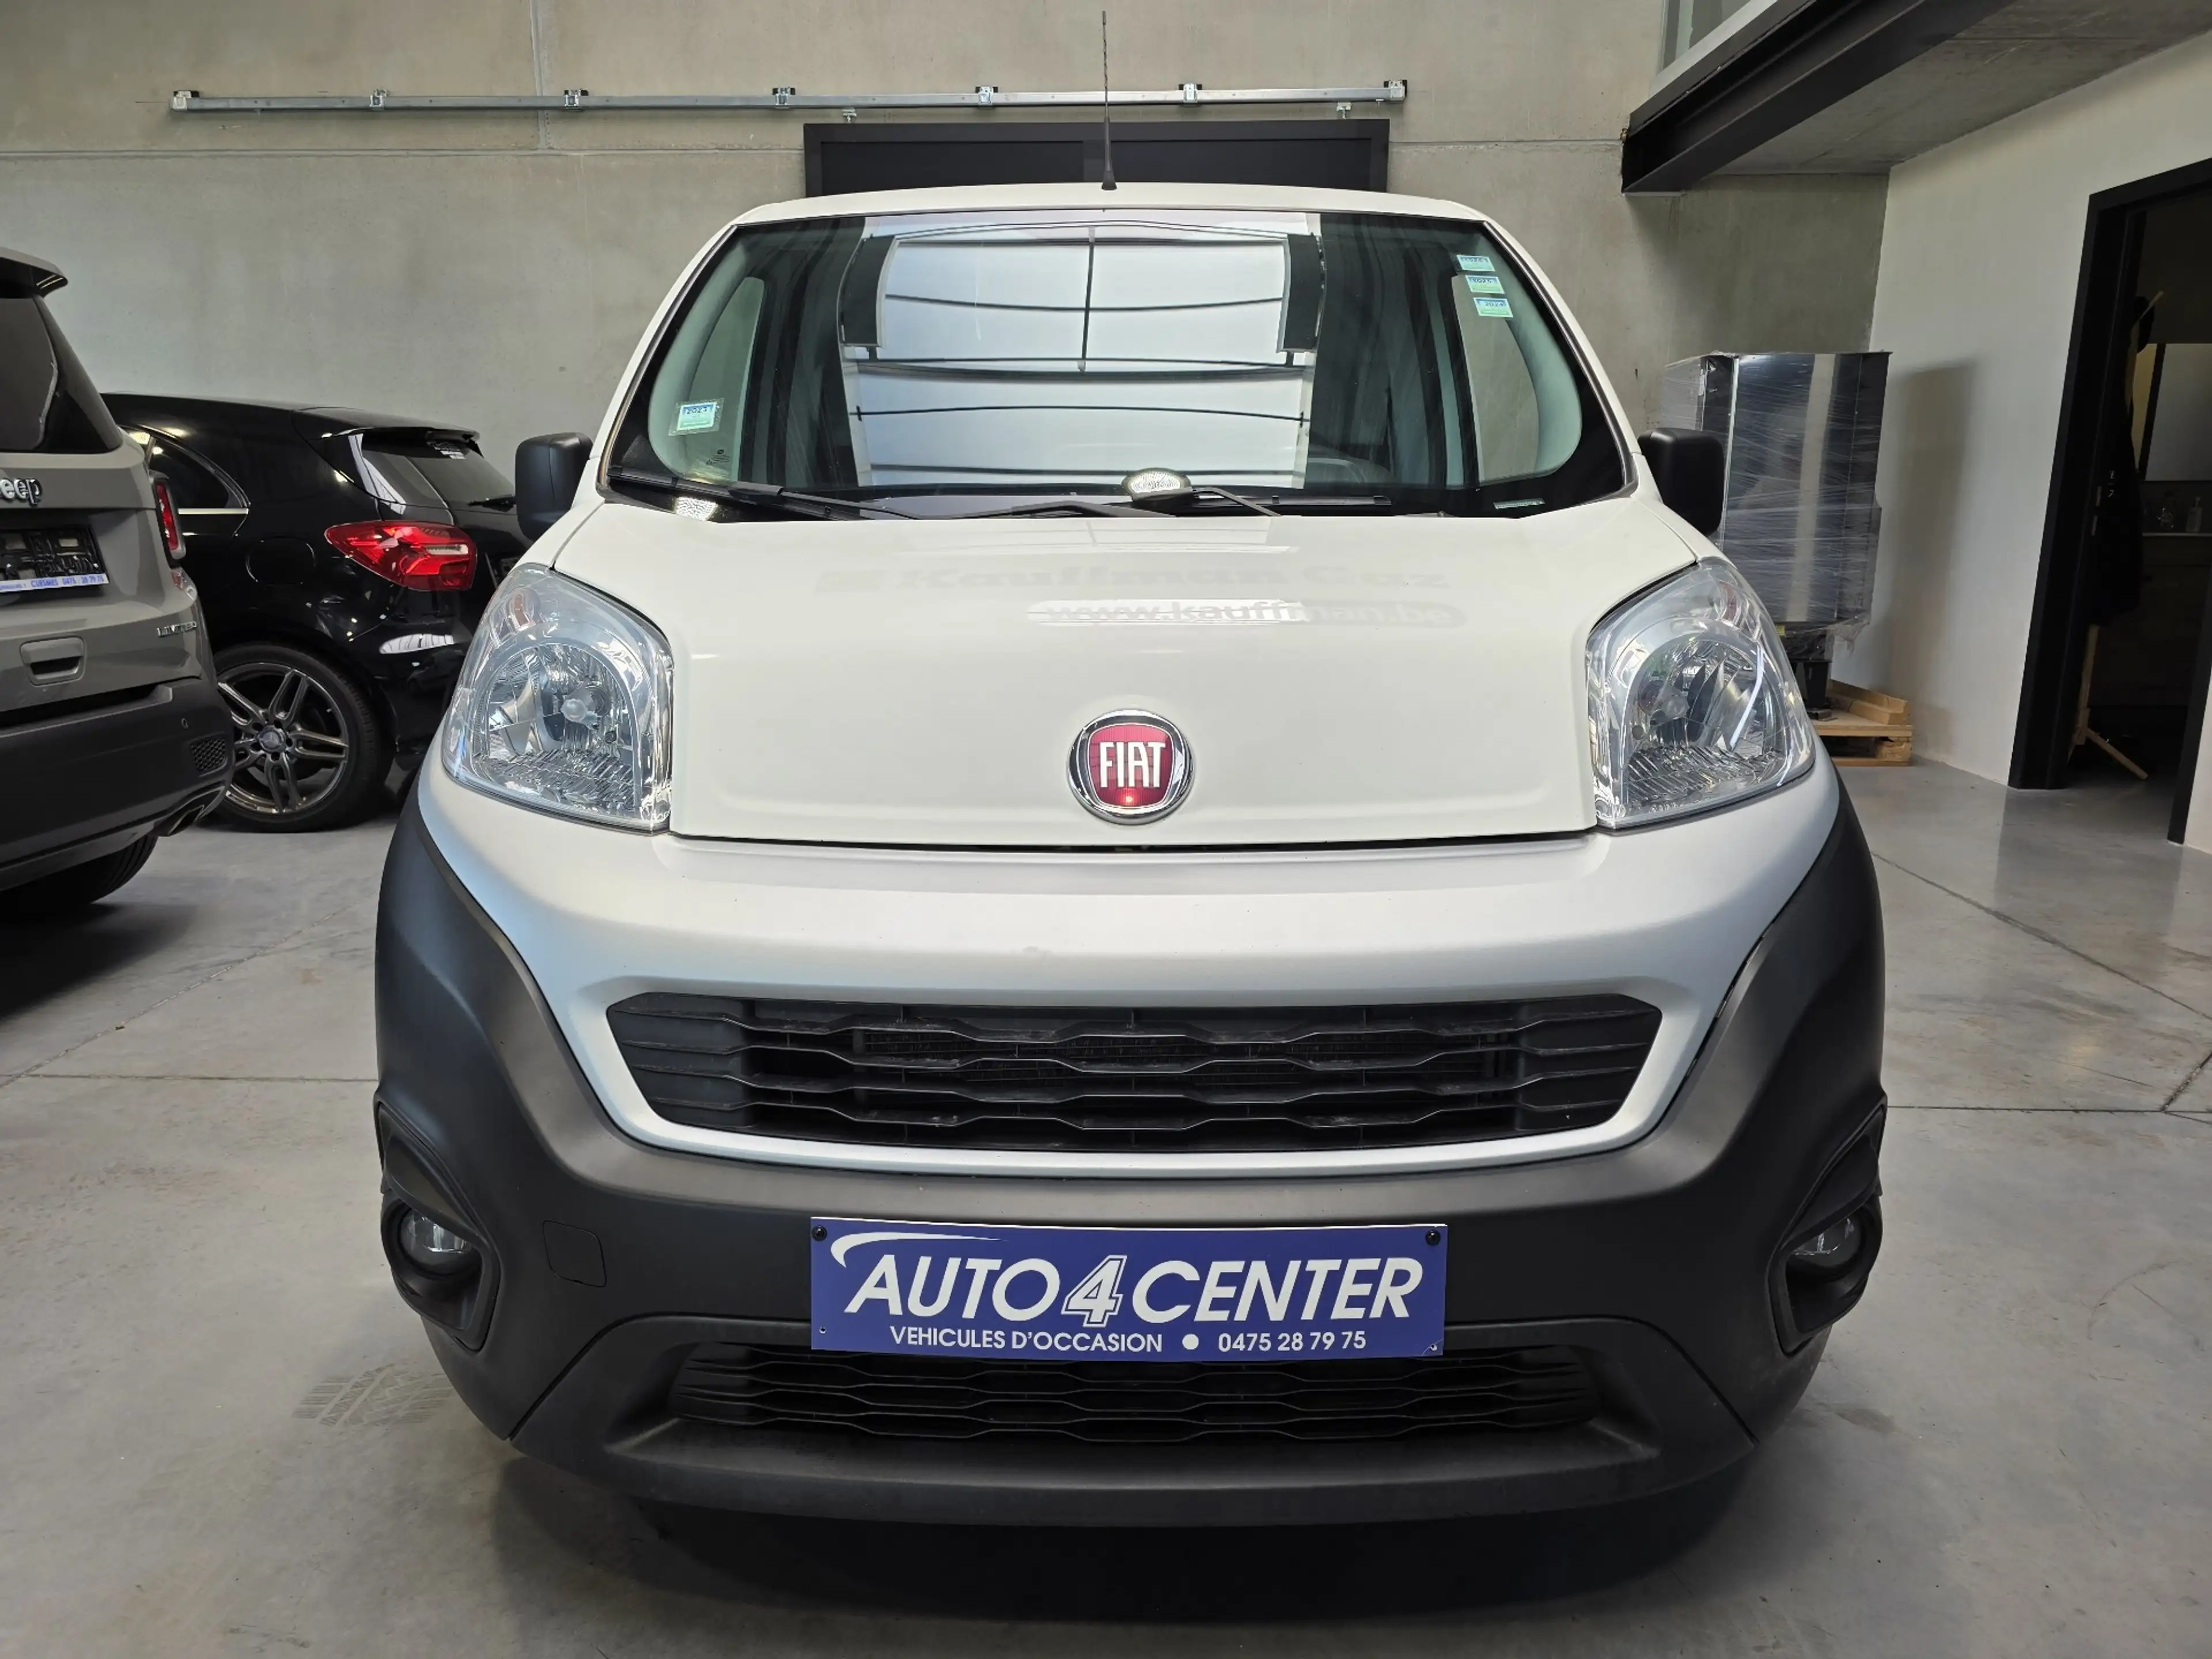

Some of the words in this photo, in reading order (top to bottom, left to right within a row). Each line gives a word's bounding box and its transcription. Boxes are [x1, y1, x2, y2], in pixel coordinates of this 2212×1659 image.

[0, 479, 41, 505] eep
[1099, 741, 1166, 788] FIAT
[889, 1325, 1006, 1349] VEHICULES
[1012, 1331, 1162, 1352] D'OCCASION
[1218, 1332, 1271, 1351] 0475
[1277, 1332, 1304, 1351] 28
[1309, 1331, 1336, 1351] 79
[1342, 1331, 1367, 1349] 75
